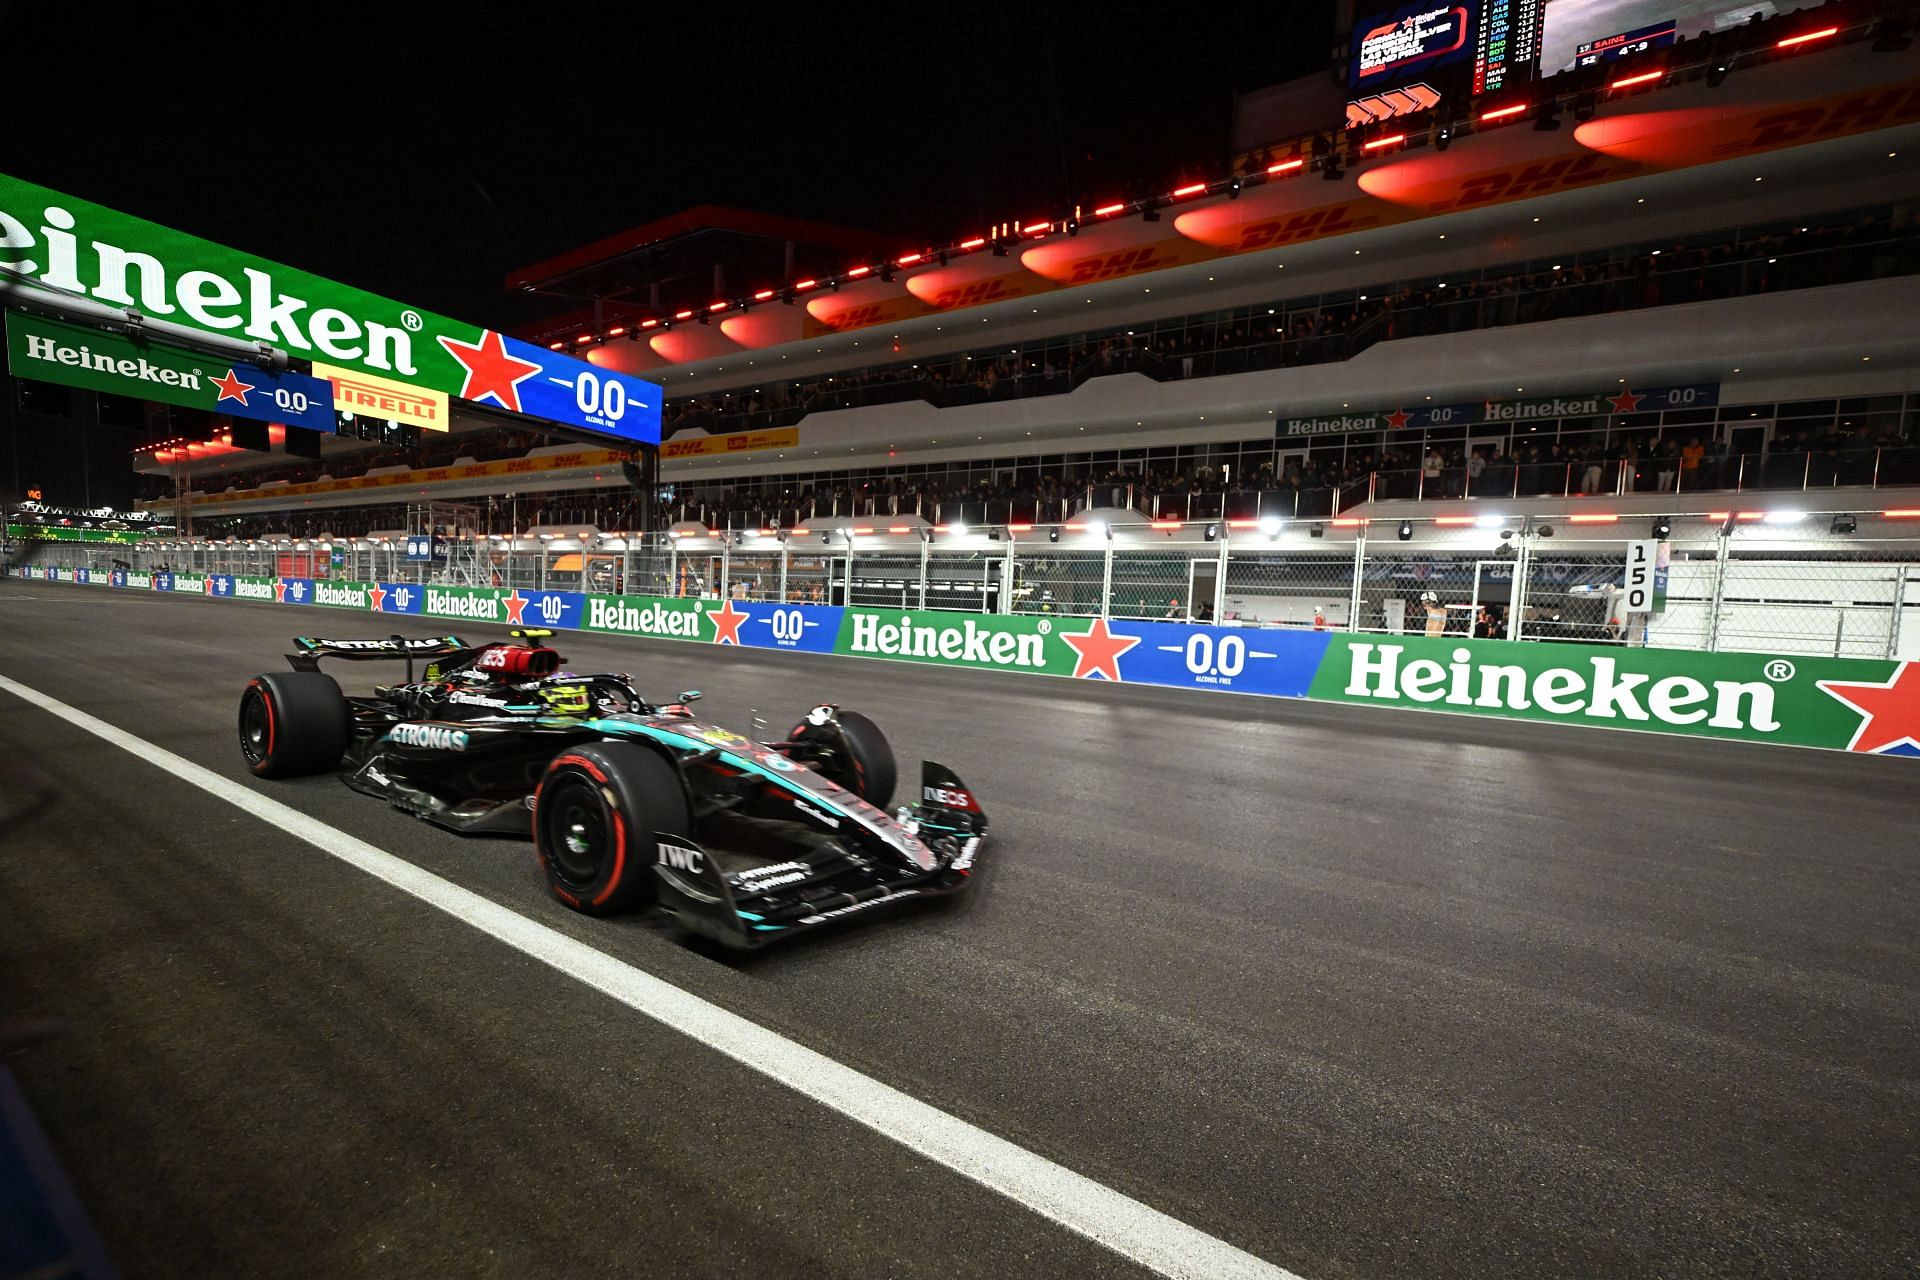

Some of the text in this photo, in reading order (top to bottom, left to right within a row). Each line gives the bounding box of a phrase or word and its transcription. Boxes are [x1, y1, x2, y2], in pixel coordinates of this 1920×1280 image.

[1493, 5, 1508, 14] ALB
[1492, 12, 1508, 20] GAS
[1491, 25, 1510, 35] LAW
[1492, 20, 1506, 28] COL
[1490, 34, 1506, 42] PER
[1580, 35, 1626, 53] 17 SAINZ
[1490, 40, 1506, 49] ZHO
[1488, 54, 1505, 63] OCO
[1487, 67, 1506, 77] MAG
[1488, 62, 1502, 70] SAI
[1486, 76, 1502, 84] HUL
[1459, 153, 1606, 200] DHL
[1240, 206, 1356, 249] DHL
[1066, 247, 1162, 284] DHL
[935, 280, 1012, 309] DHL
[825, 305, 884, 332] DHL
[327, 375, 437, 420] PIRELLI
[576, 371, 625, 421] 0.0
[606, 419, 616, 428] FREE
[667, 441, 705, 457] DHL
[508, 460, 532, 472] DHL
[554, 454, 582, 467] DHL
[464, 466, 488, 476] DHL
[772, 610, 803, 641] 0.0
[1186, 634, 1245, 677] 0.0
[1195, 675, 1232, 686] ALCOHOL FREE
[924, 786, 969, 807] INEOS
[656, 842, 704, 874] IWC
